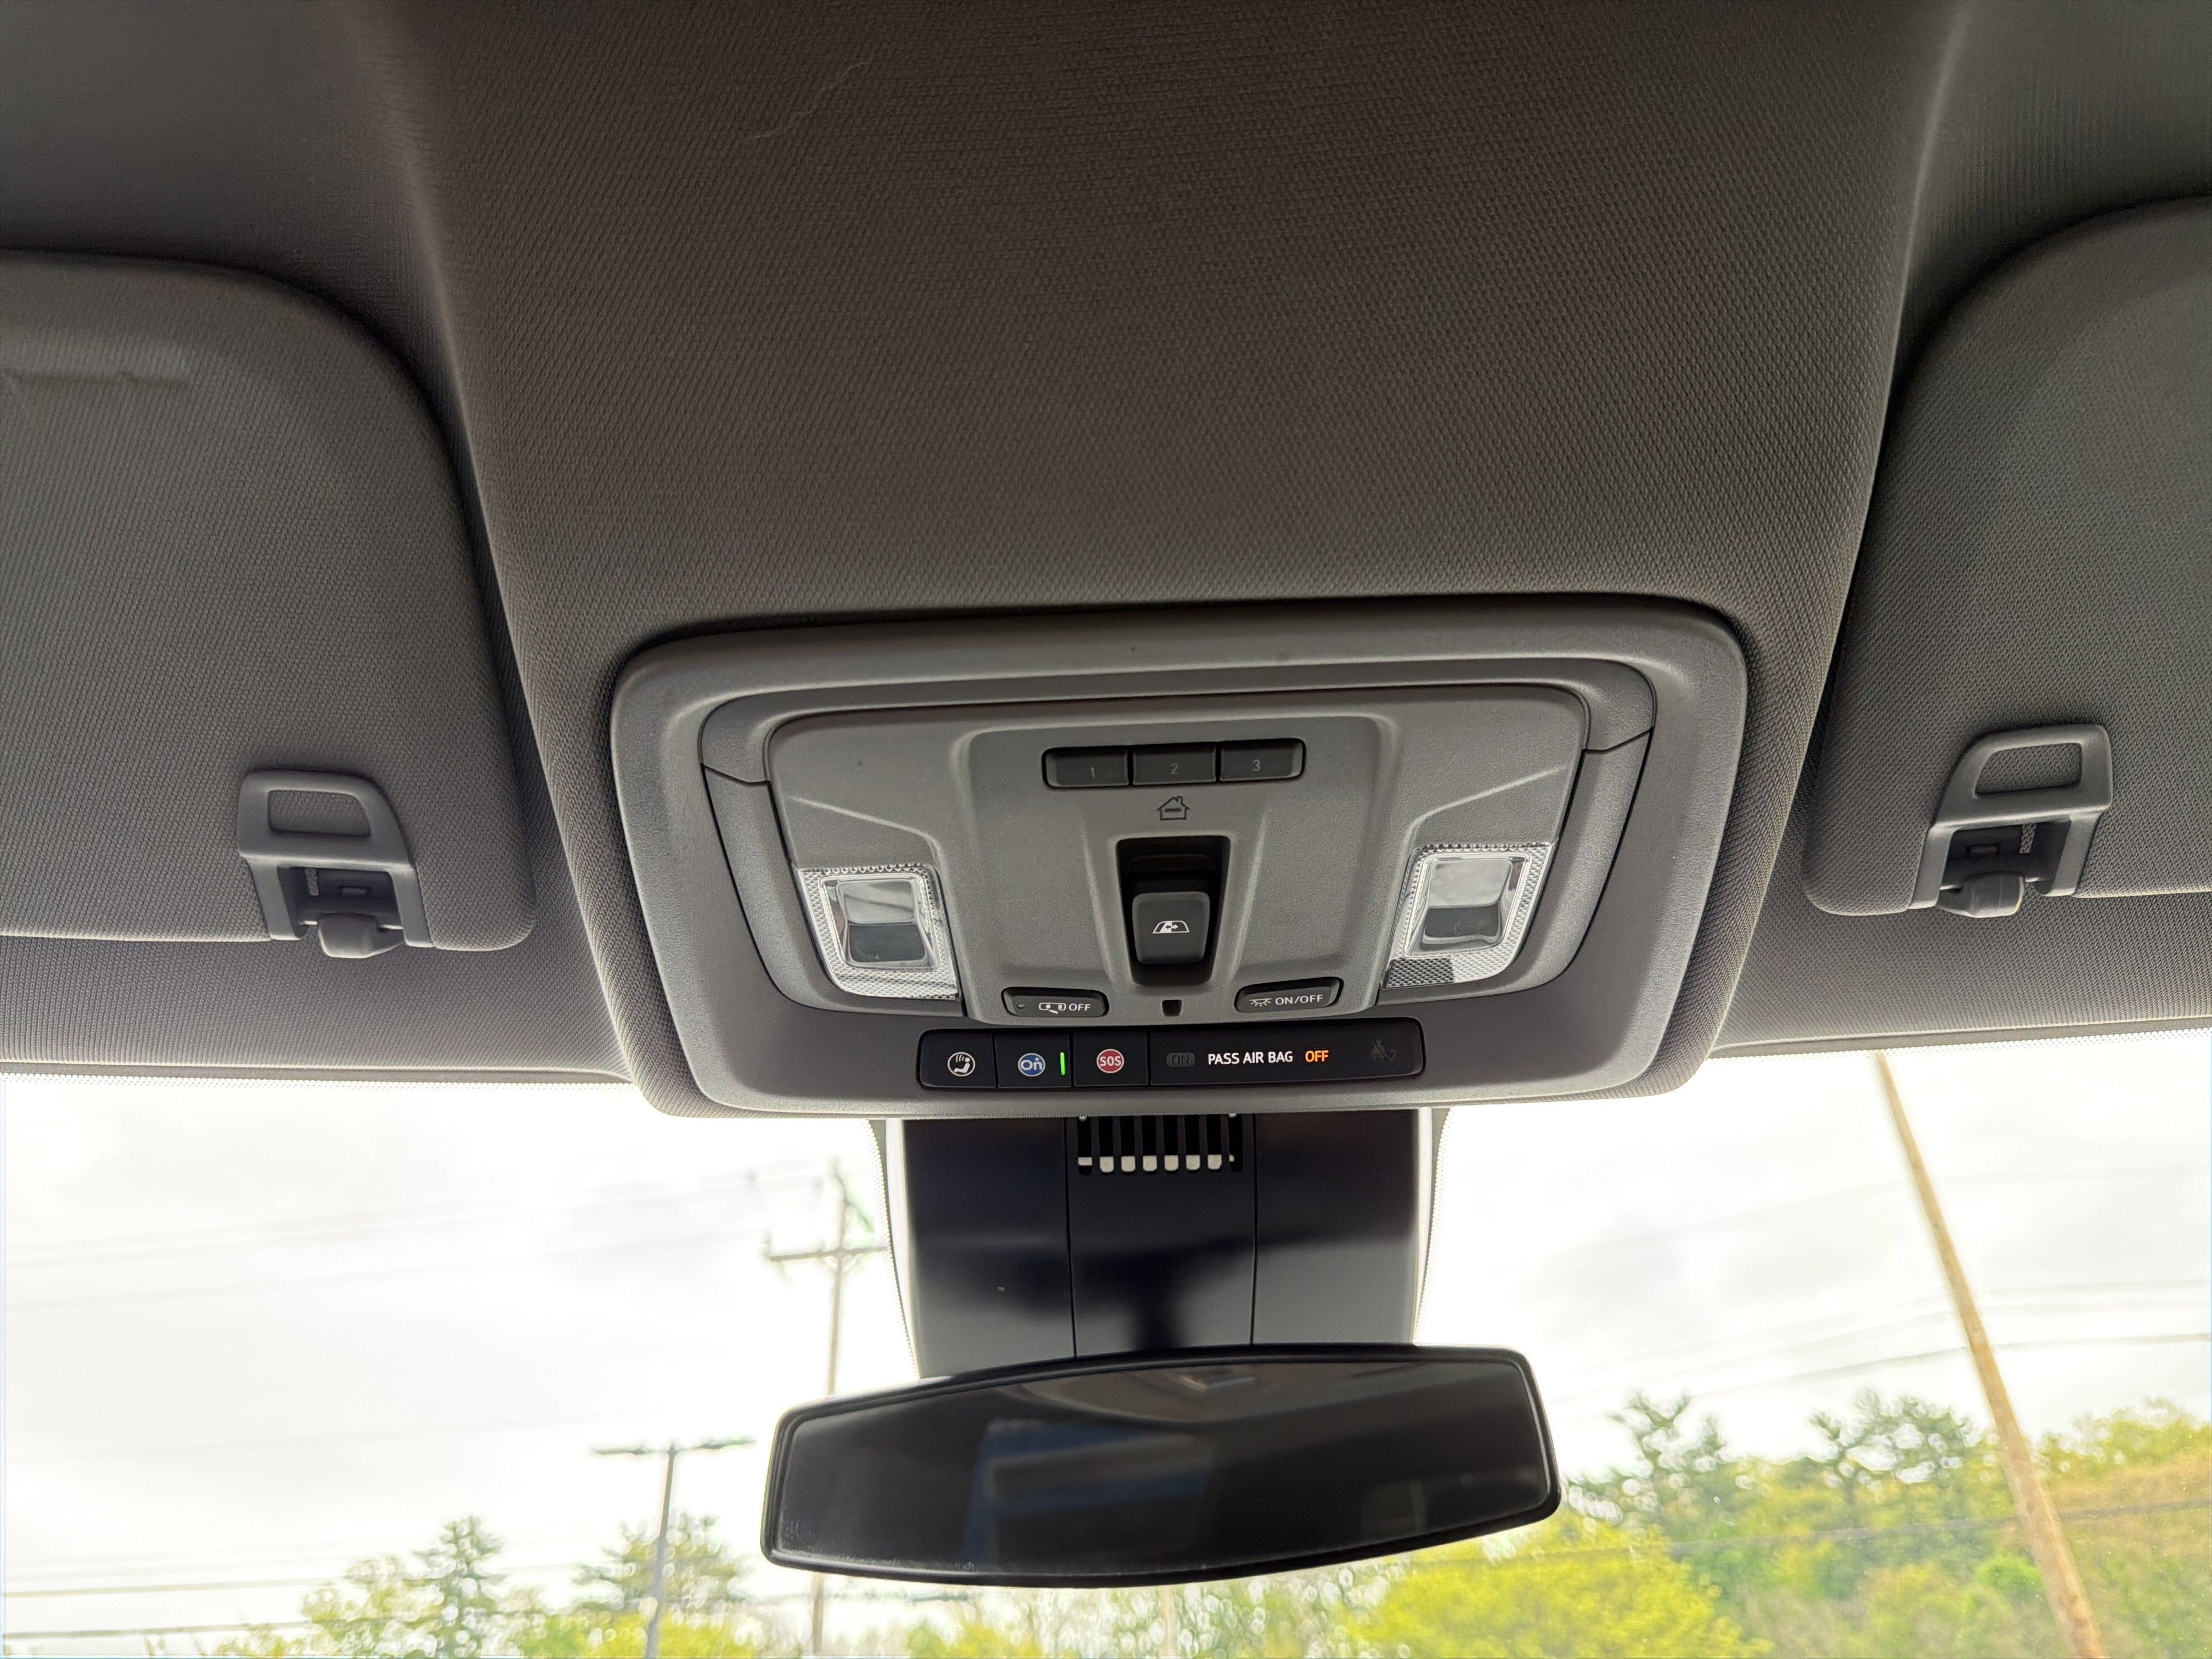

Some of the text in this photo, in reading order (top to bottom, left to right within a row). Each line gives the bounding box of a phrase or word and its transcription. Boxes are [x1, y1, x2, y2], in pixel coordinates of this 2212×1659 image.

[1170, 763, 1178, 775] 2
[1252, 759, 1261, 772] 3
[1091, 767, 1096, 778] 1
[1275, 994, 1324, 1005] ON/OFF
[1069, 1003, 1091, 1012] OFF
[1099, 1056, 1121, 1066] SOS
[1172, 1055, 1189, 1065] ON
[1208, 1050, 1329, 1065] PASS AIR BAG OFF
